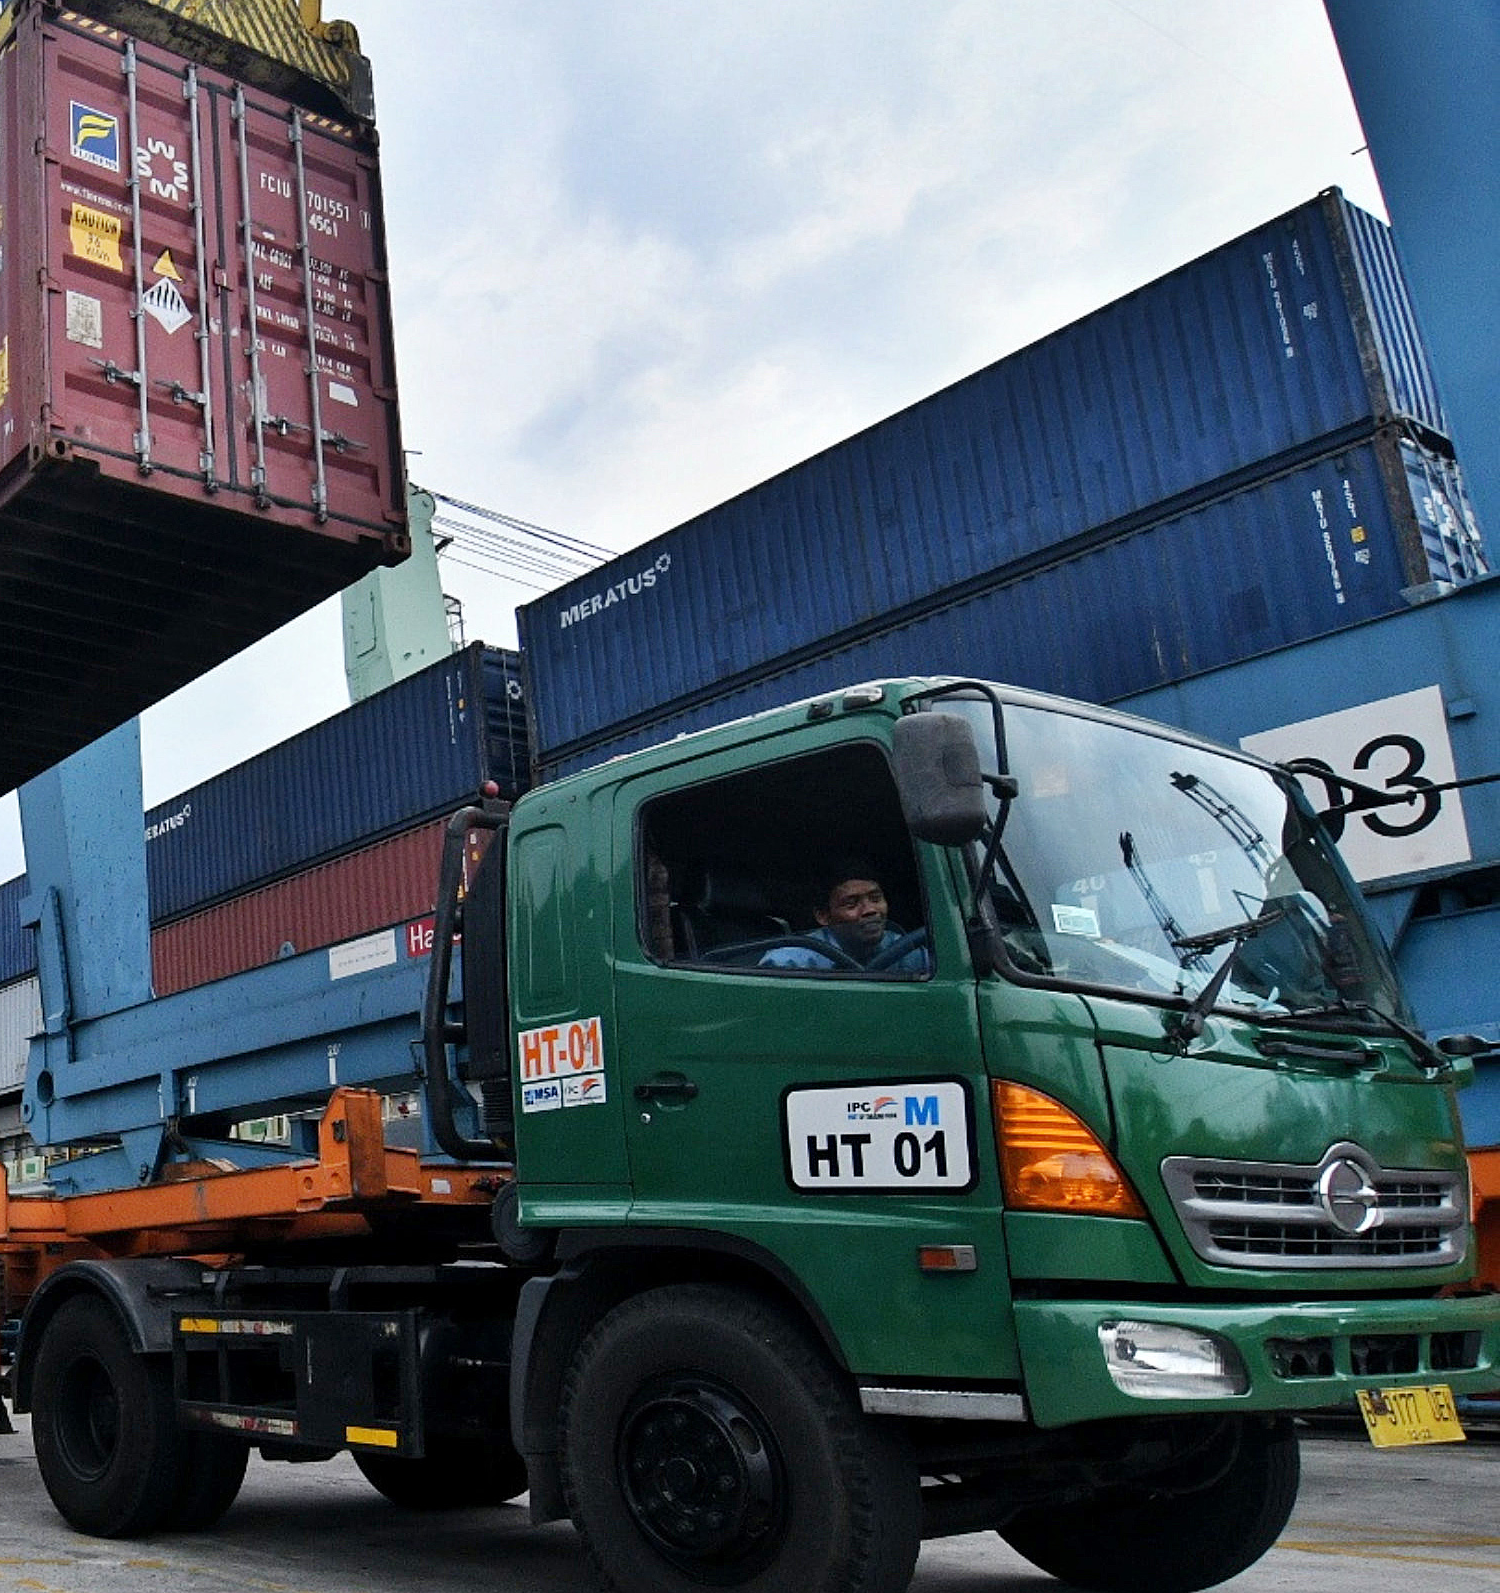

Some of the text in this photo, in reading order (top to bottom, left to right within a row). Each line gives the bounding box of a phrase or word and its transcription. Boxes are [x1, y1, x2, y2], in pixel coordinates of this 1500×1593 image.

[260, 172, 291, 198] FCIU
[307, 191, 349, 222] 701551
[75, 210, 117, 234] CAUTION
[560, 568, 657, 629] MERATUS
[145, 813, 184, 842] ERATUS
[411, 924, 435, 952] Ha
[523, 1019, 599, 1078] HT-01
[535, 1086, 558, 1100] MSA
[847, 1102, 871, 1112] IPC
[905, 1096, 939, 1125] M
[807, 1130, 948, 1177] HT 01
